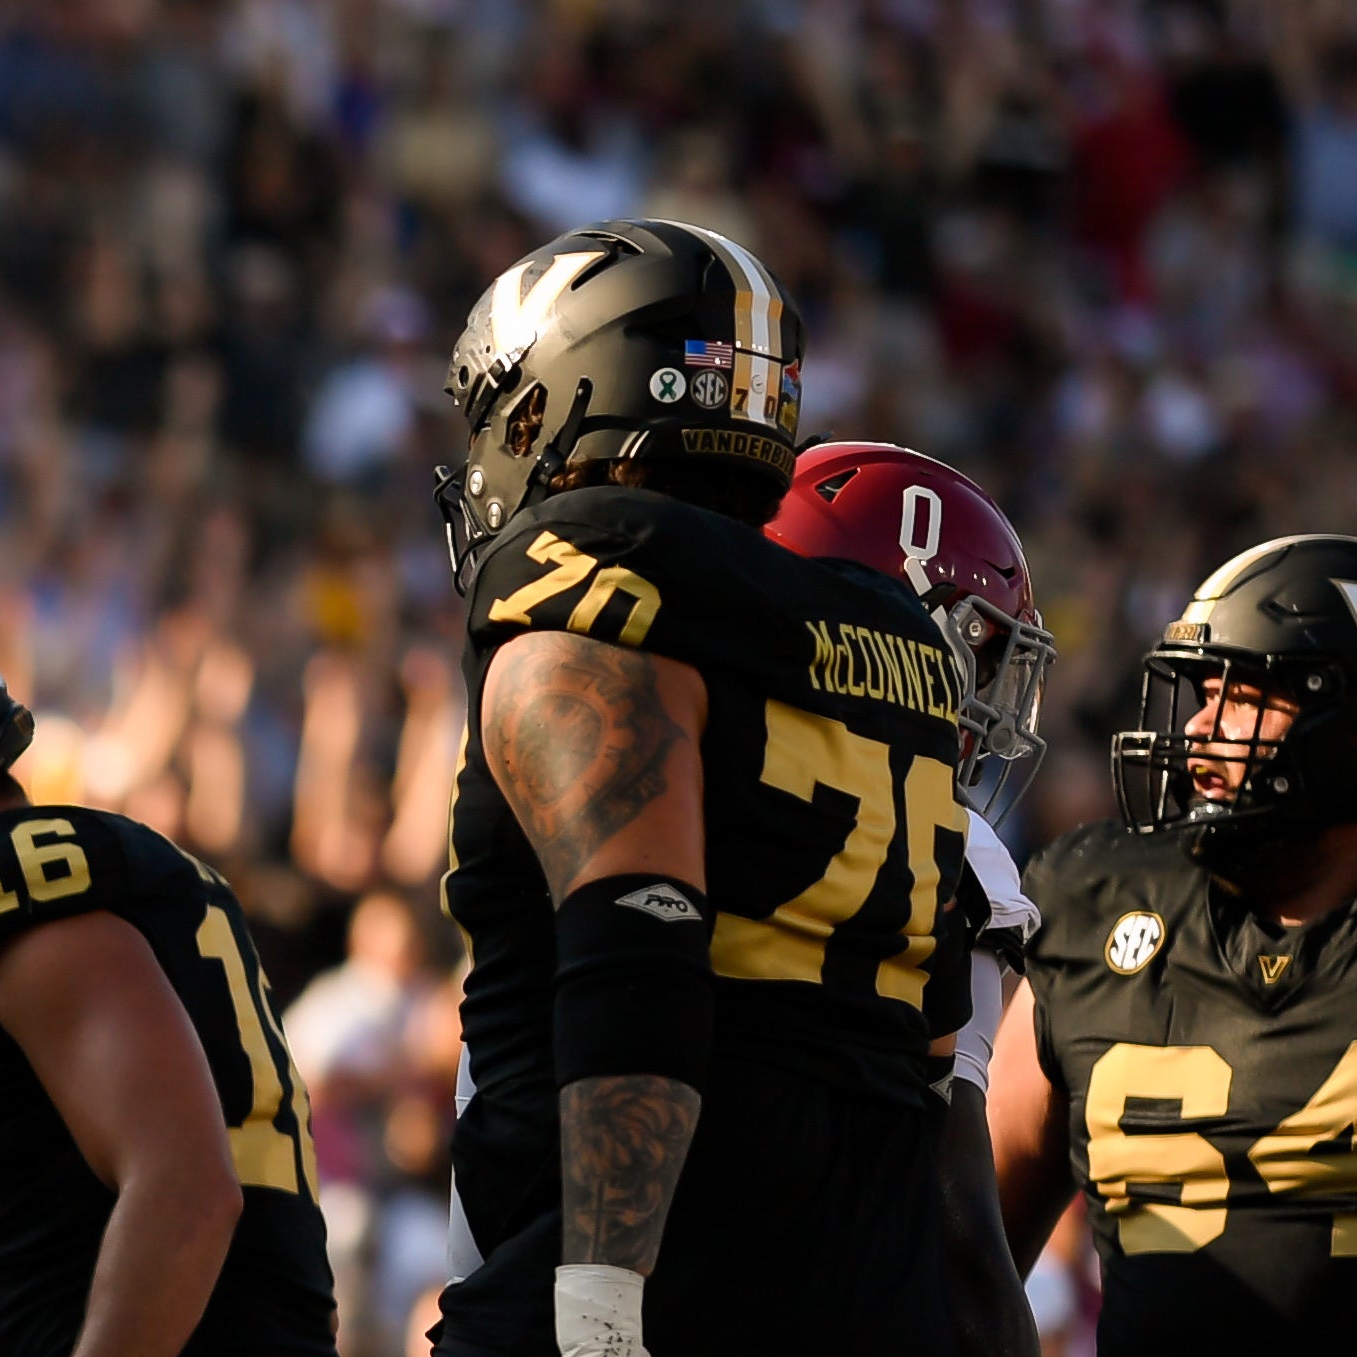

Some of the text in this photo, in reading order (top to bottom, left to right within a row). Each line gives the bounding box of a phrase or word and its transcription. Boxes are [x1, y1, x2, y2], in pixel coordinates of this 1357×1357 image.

[694, 372, 725, 406] SEC
[733, 387, 777, 418] 7 0
[682, 428, 796, 474] VANDERBI
[899, 485, 942, 560] 0
[644, 893, 689, 913] PRO
[1109, 914, 1161, 971] SEC
[1084, 1039, 1357, 1258] 64
